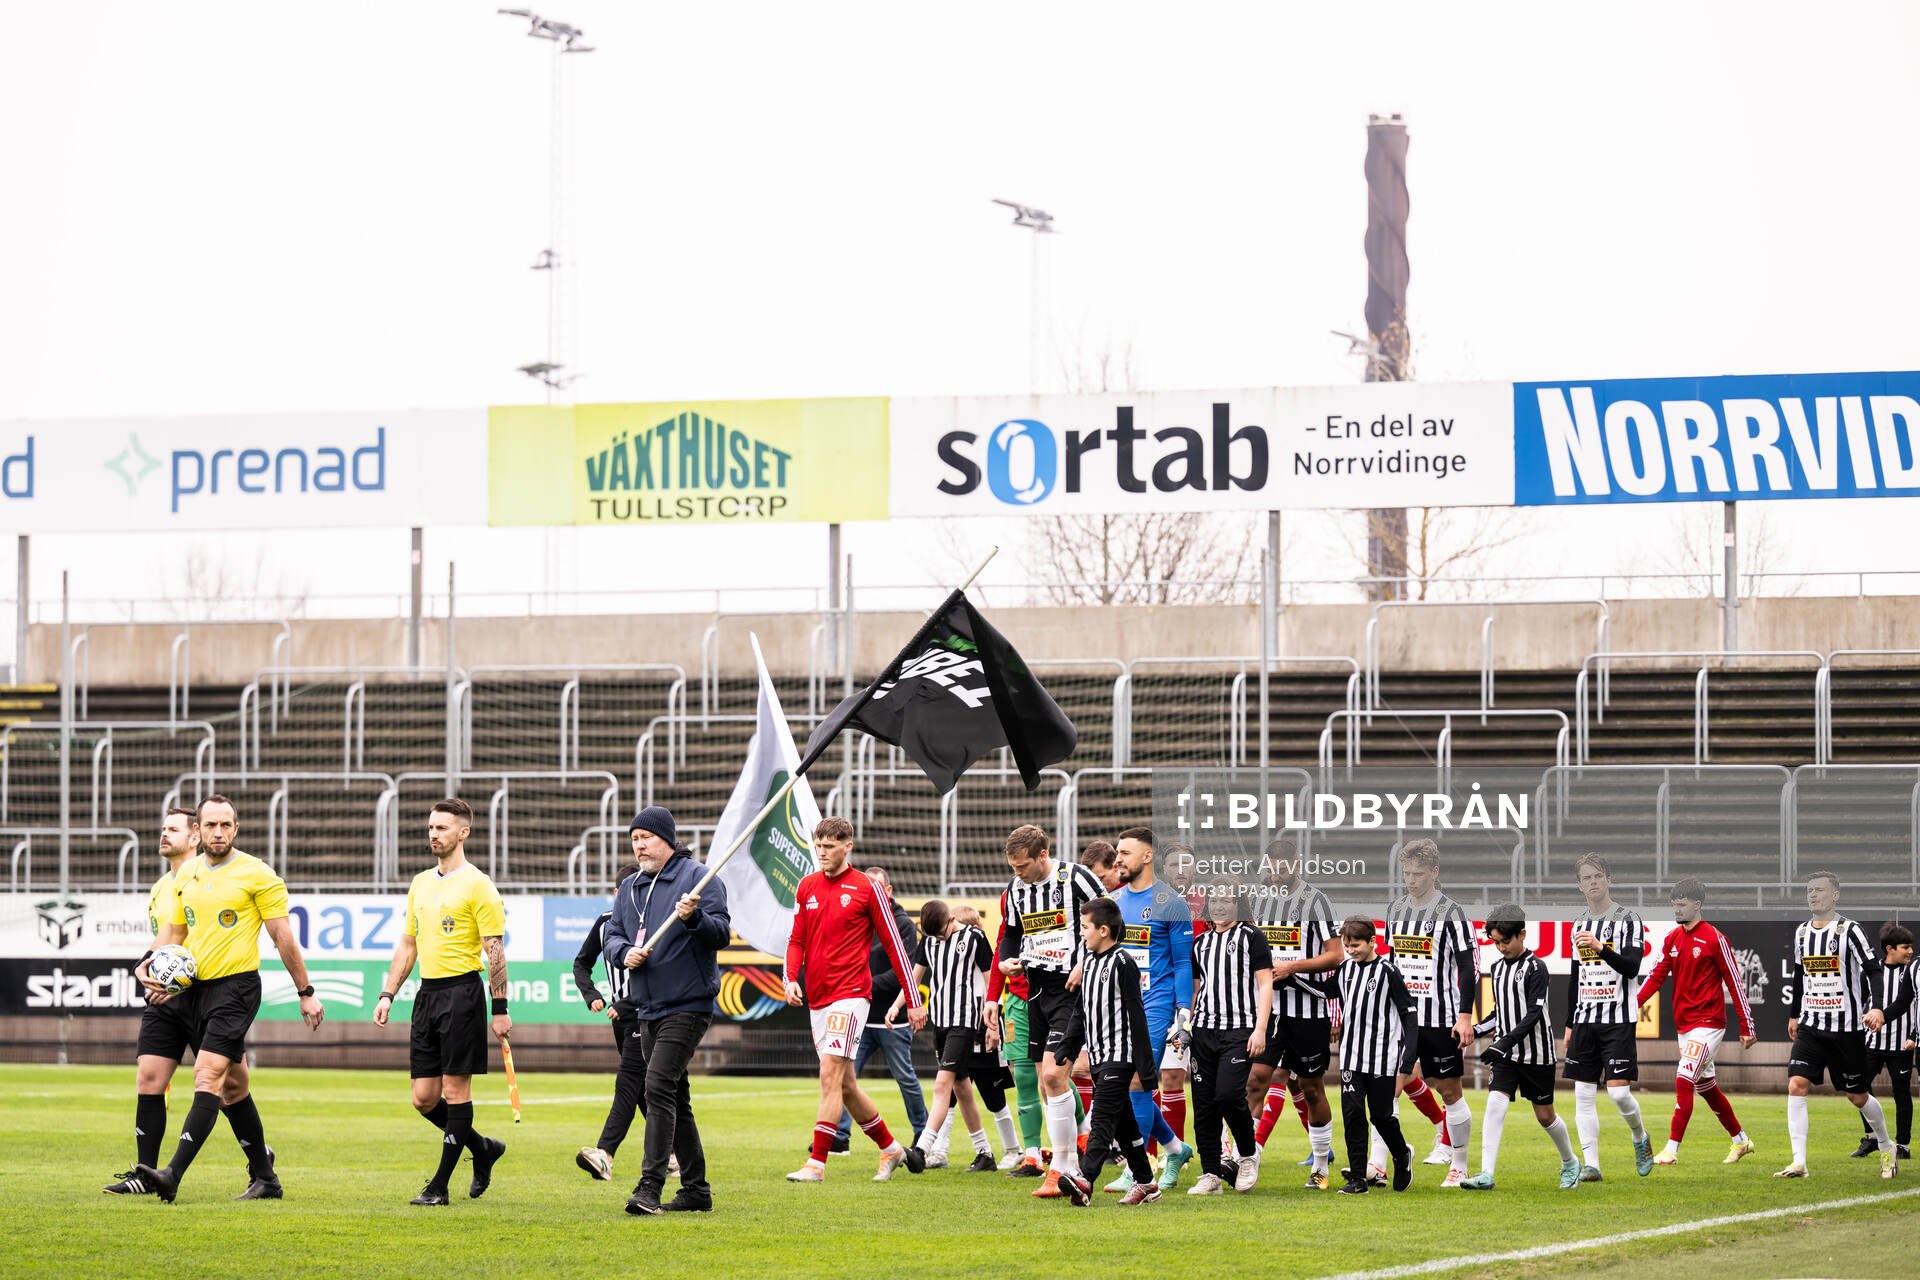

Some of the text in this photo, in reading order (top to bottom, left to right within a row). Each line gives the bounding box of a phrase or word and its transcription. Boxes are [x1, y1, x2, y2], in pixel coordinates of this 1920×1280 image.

[1326, 415, 1361, 439] En
[1370, 414, 1413, 437] del
[1422, 416, 1455, 437] av
[172, 427, 385, 513] prenad
[585, 411, 792, 491] VÄXTHUSET
[937, 403, 1269, 505] sortab
[1294, 449, 1467, 479] Norrvidinge
[590, 496, 787, 520] TULLSTORP
[768, 827, 815, 876] SUPERETTA
[160, 959, 180, 983] SELECT
